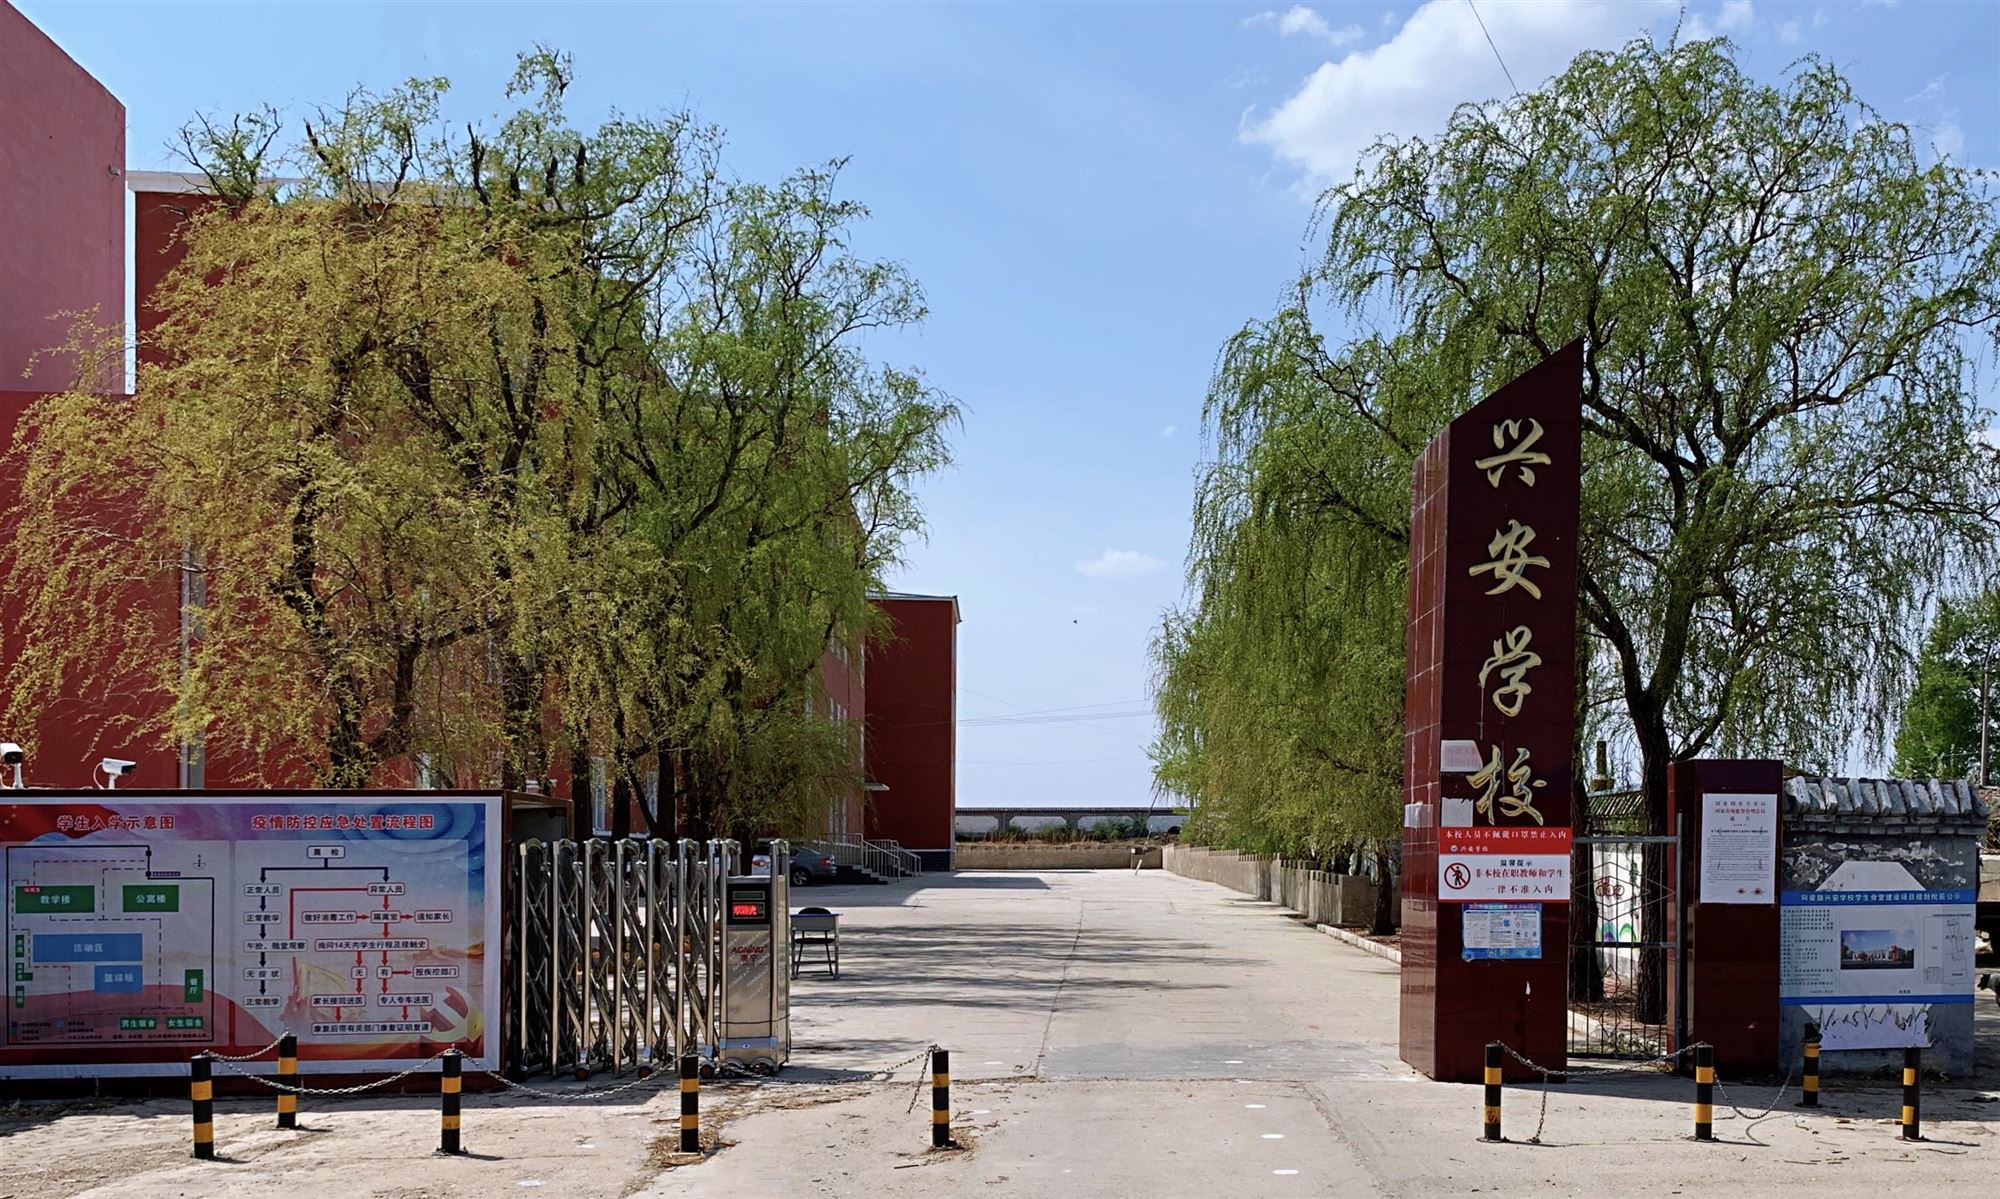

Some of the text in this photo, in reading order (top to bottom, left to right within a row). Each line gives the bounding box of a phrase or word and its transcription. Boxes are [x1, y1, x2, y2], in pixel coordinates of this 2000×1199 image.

[1466, 417, 1551, 826] 兴安学校
[57, 815, 175, 831] 学生入学示意图
[251, 814, 434, 830] 疫情防控应急处置流程图
[1446, 830, 1567, 839] 本校人员不佩戴口罩禁止入内
[1500, 859, 1533, 867] 温馨提示
[1475, 869, 1564, 878] 非本校在职教师和学生
[246, 886, 280, 895] 正常人员
[370, 885, 403, 894] 异常人员
[1486, 884, 1554, 894] 一律不准入内
[40, 894, 71, 905] 教学楼
[136, 894, 166, 904] 公寓楼
[246, 913, 280, 922] 正常教学
[304, 912, 354, 922] 做好消毒工作
[417, 912, 450, 921] 通知家长
[354, 968, 364, 977] 无
[380, 968, 389, 977] 有
[415, 967, 458, 977] 报疾控部门
[246, 997, 280, 1006] 正常教学
[121, 1018, 156, 1028] 男生宿舍
[167, 1018, 202, 1028] 女生宿舍
